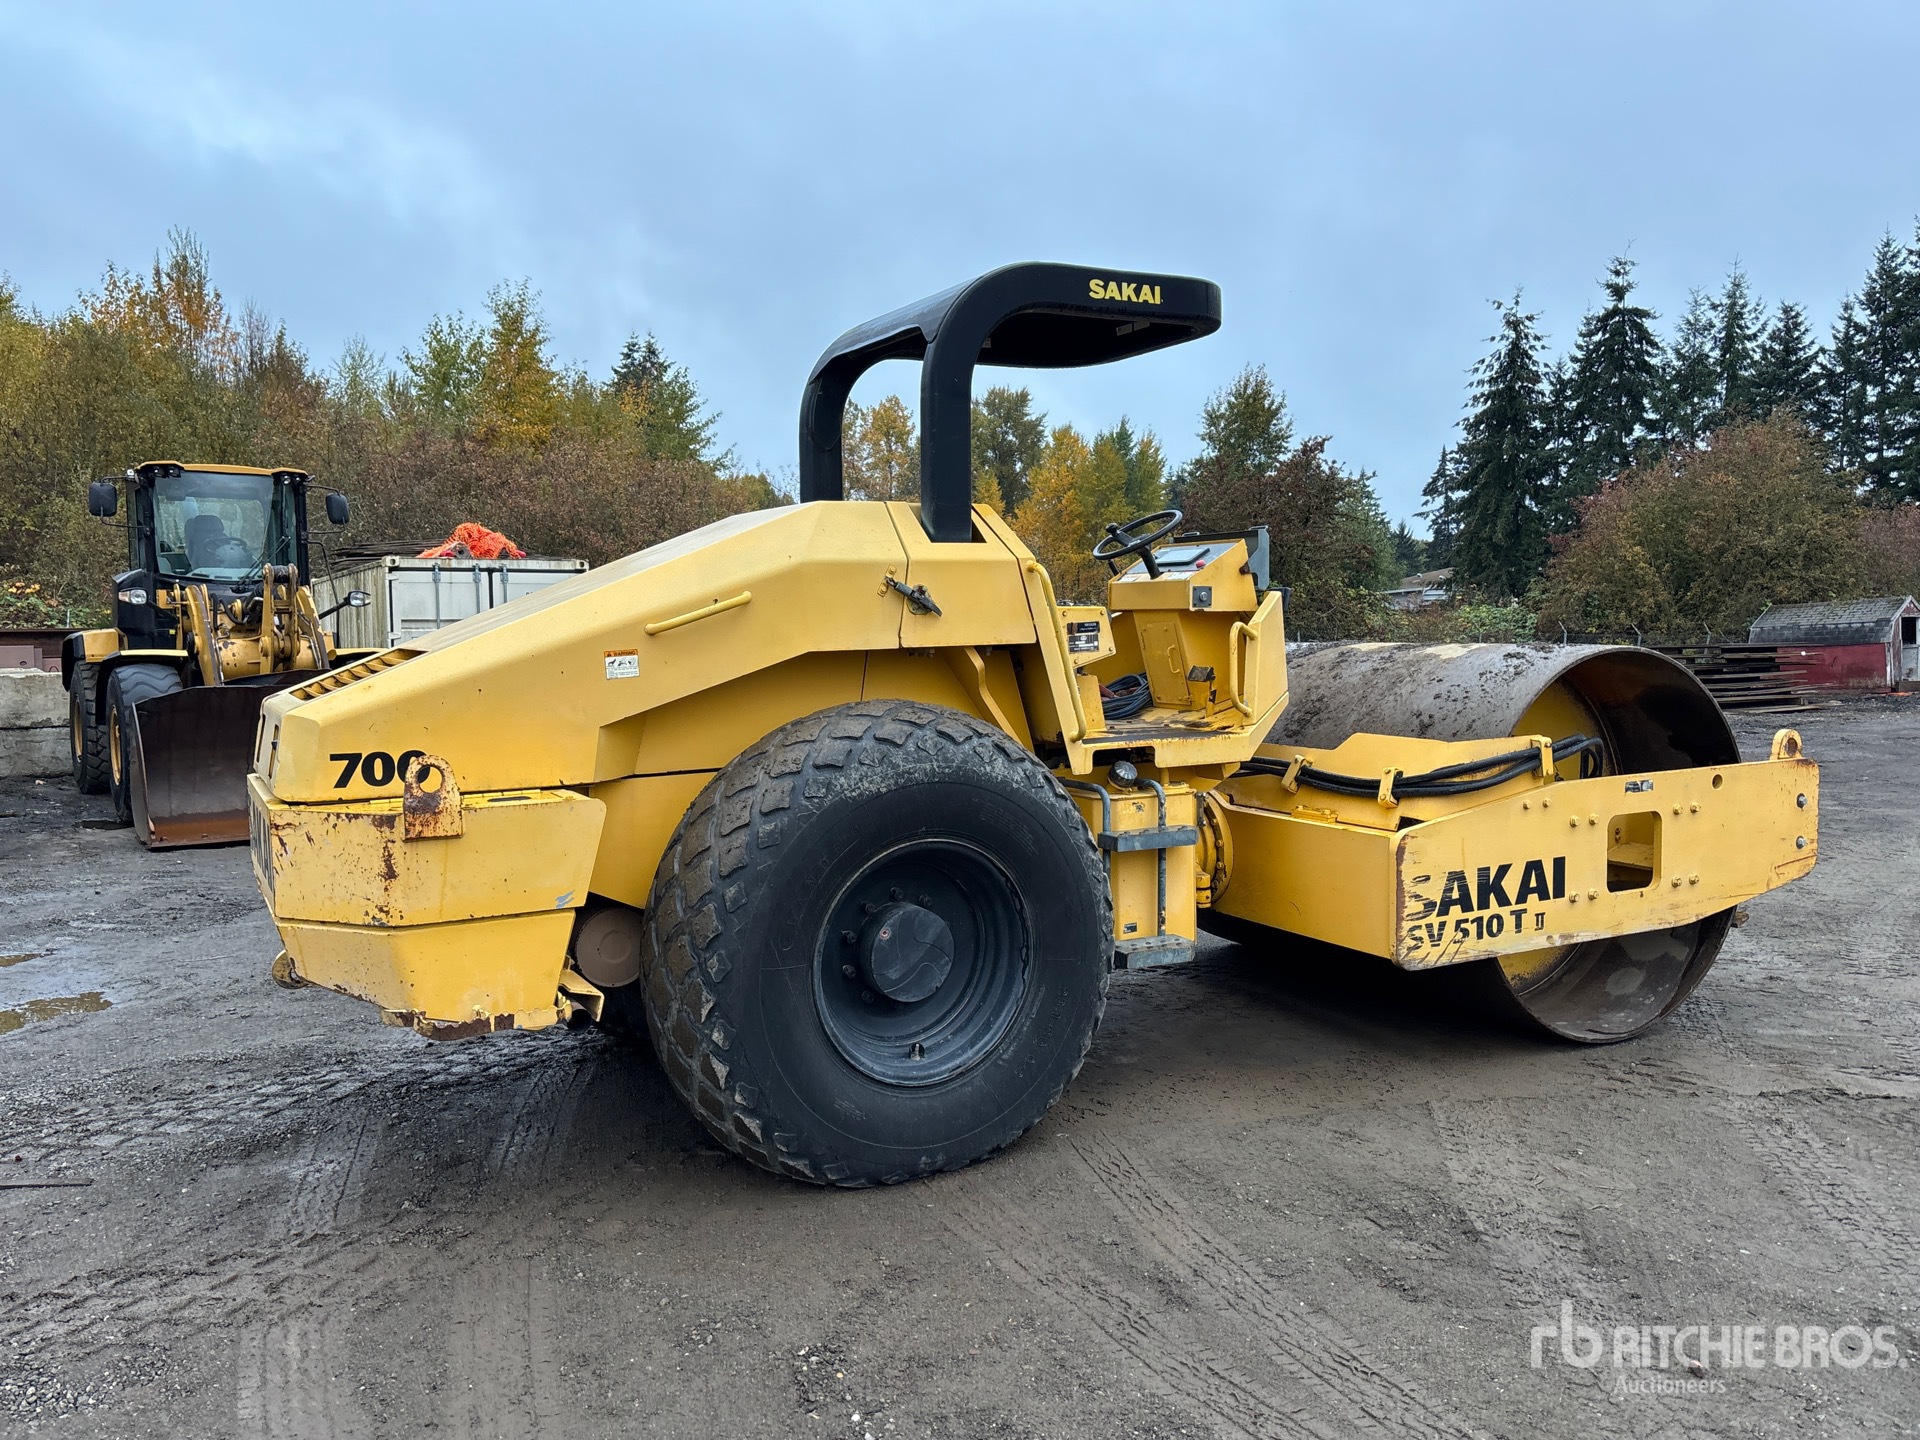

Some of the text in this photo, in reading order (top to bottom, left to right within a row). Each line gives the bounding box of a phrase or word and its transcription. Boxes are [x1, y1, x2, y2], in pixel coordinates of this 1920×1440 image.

[1088, 279, 1161, 305] SAKAI
[329, 750, 431, 788] 700
[1405, 856, 1566, 922] SAKAI
